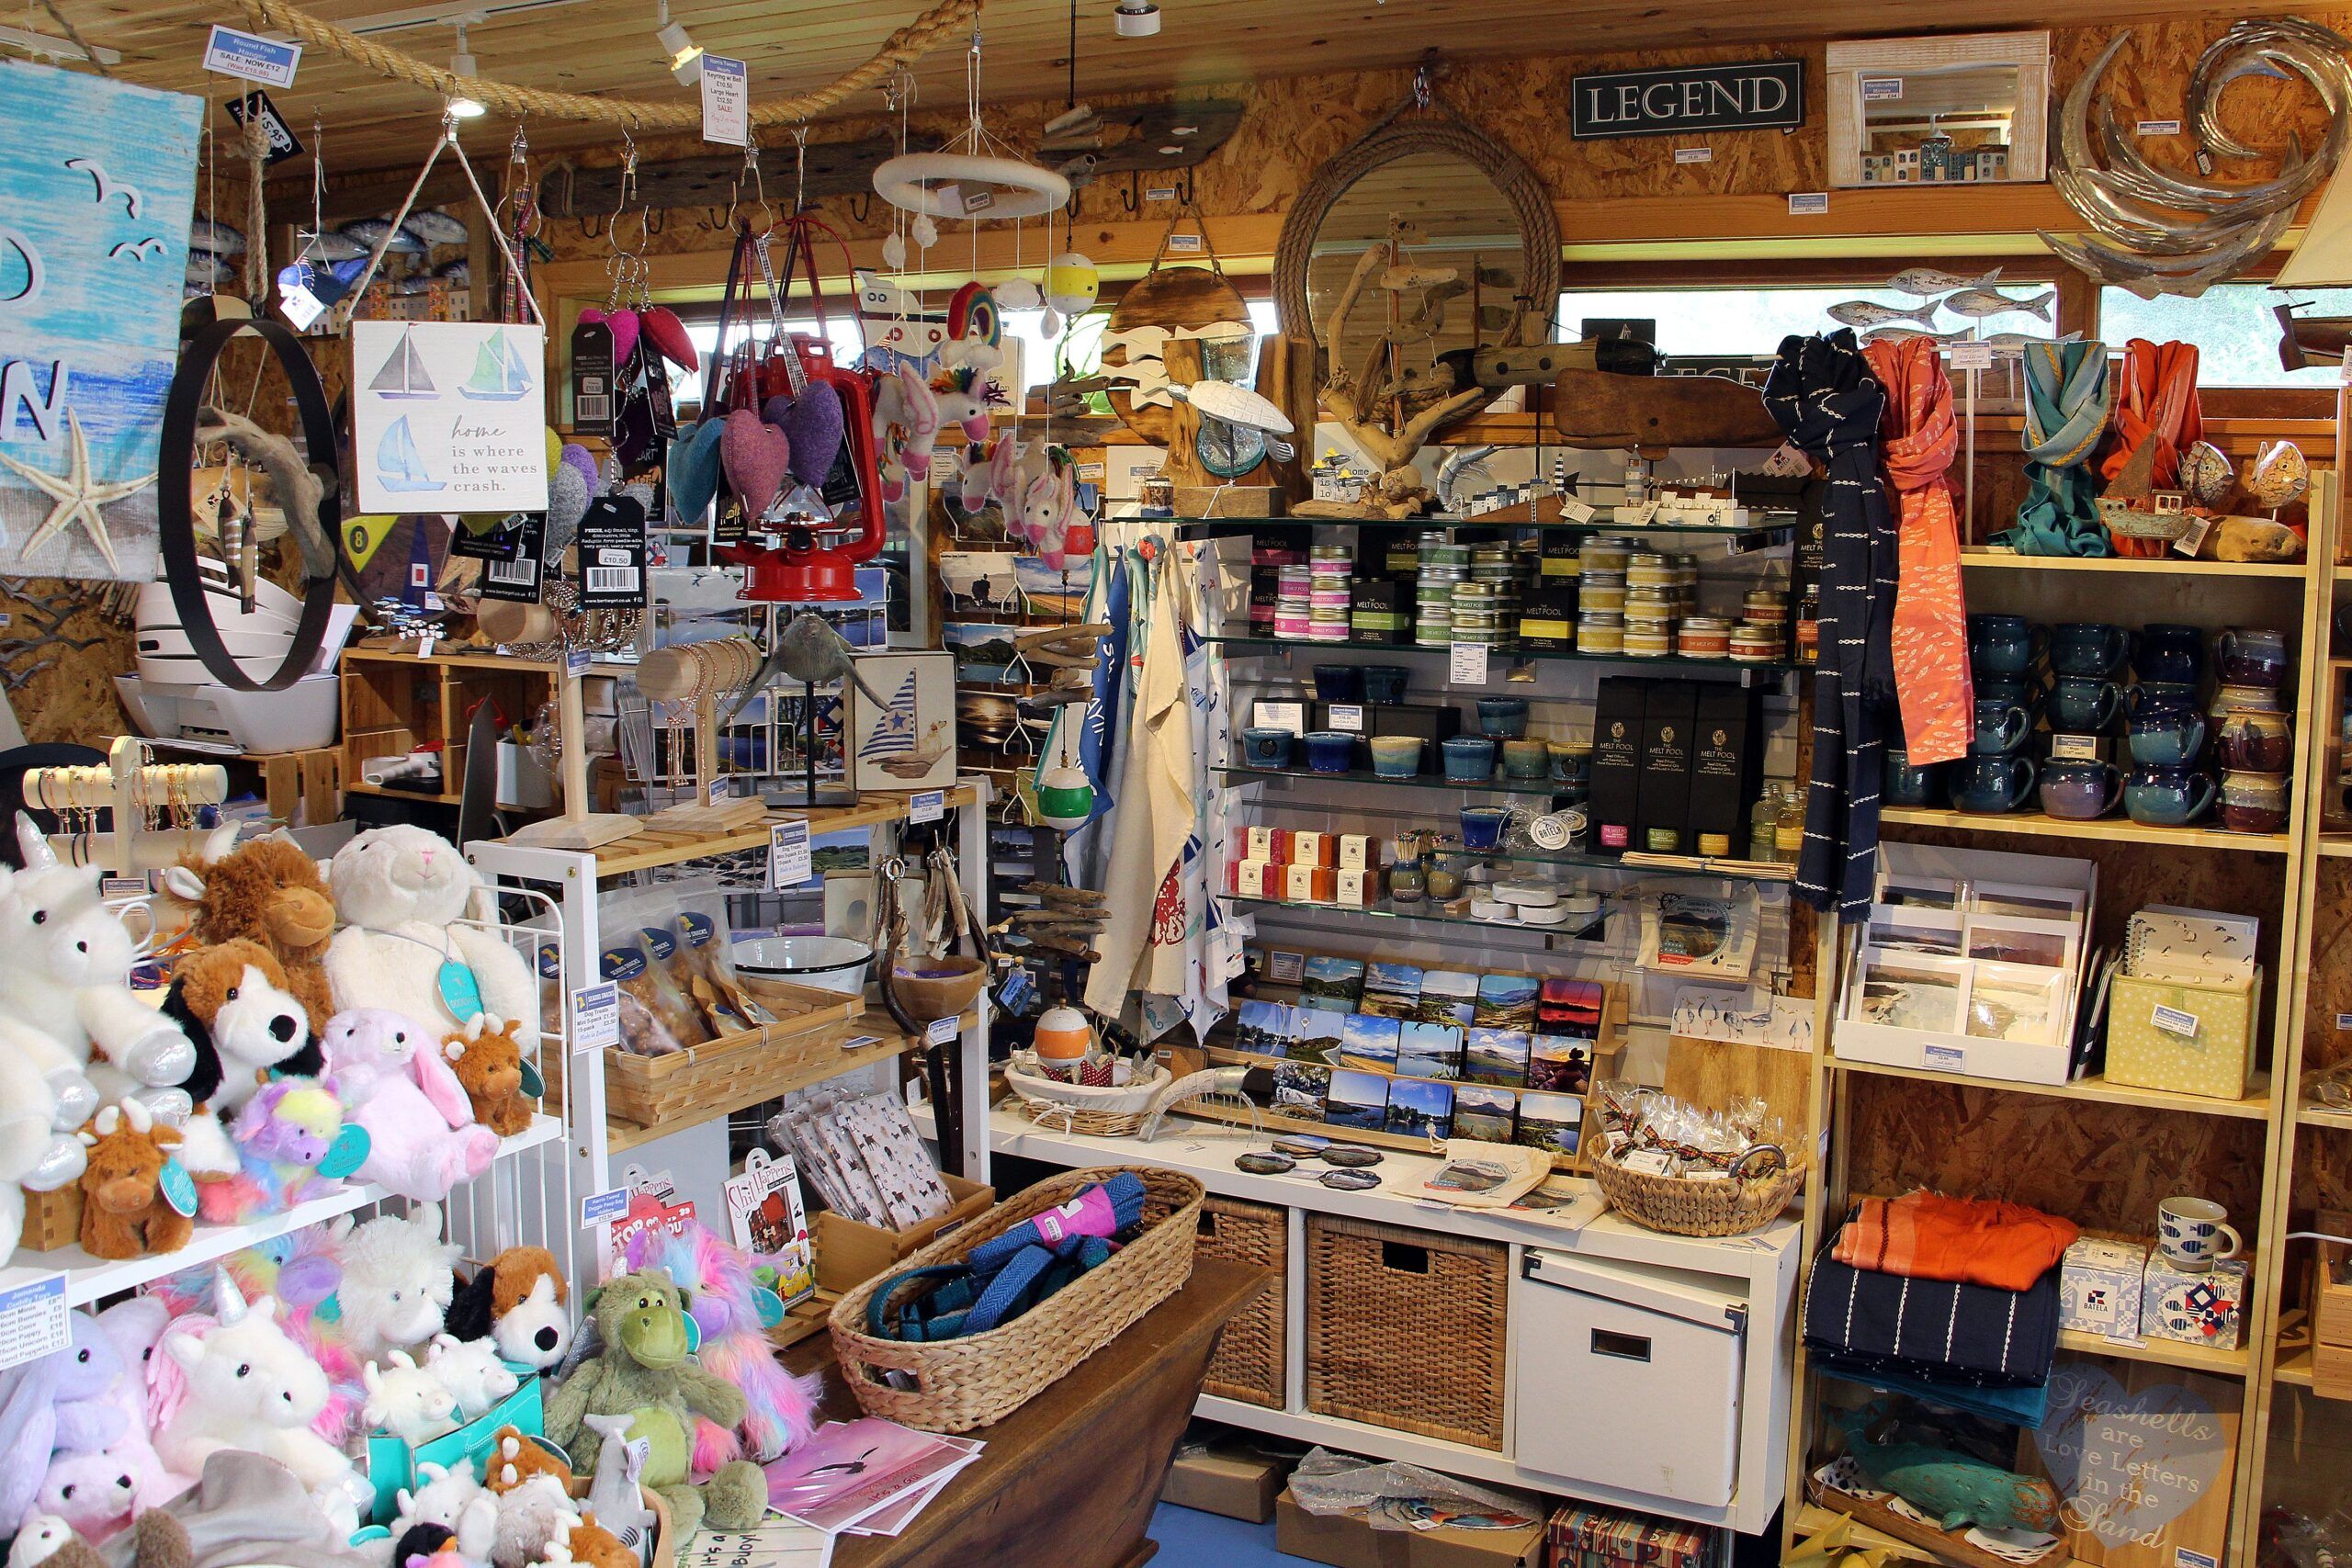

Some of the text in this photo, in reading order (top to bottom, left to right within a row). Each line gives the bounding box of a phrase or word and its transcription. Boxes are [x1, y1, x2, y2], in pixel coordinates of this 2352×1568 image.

[260, 44, 277, 55] Fish
[244, 59, 264, 68] NOW
[266, 63, 281, 73] £12
[707, 72, 726, 81] Keyring
[711, 88, 724, 96] Large
[1586, 76, 1788, 124] LEGEND
[451, 414, 507, 439] home
[452, 445, 525, 457] is where
[453, 463, 537, 474] the waves
[454, 479, 506, 492] crash.
[354, 531, 363, 547] 8
[604, 556, 628, 564] £10.50
[1539, 826, 1562, 838] BATELA
[690, 928, 708, 937] SNACKS
[653, 942, 670, 952] SNACKS
[729, 1179, 757, 1219] Shit
[7, 1292, 52, 1309] Cuddly Toys
[18, 1305, 37, 1314] Minis
[2083, 1302, 2108, 1313] BATELA
[18, 1311, 47, 1322] Bunnies
[18, 1322, 37, 1331] Coos
[19, 1330, 42, 1342] Puppy
[19, 1337, 48, 1348] Unicorn
[20, 1344, 49, 1358] Puppets
[2046, 1371, 2217, 1441] Seashells
[2101, 1426, 2144, 1449] are
[2043, 1433, 2199, 1494] Love Letters
[2085, 1472, 2159, 1508] in the
[2059, 1495, 2166, 1549] Sand
[700, 1534, 727, 1568] It's a
